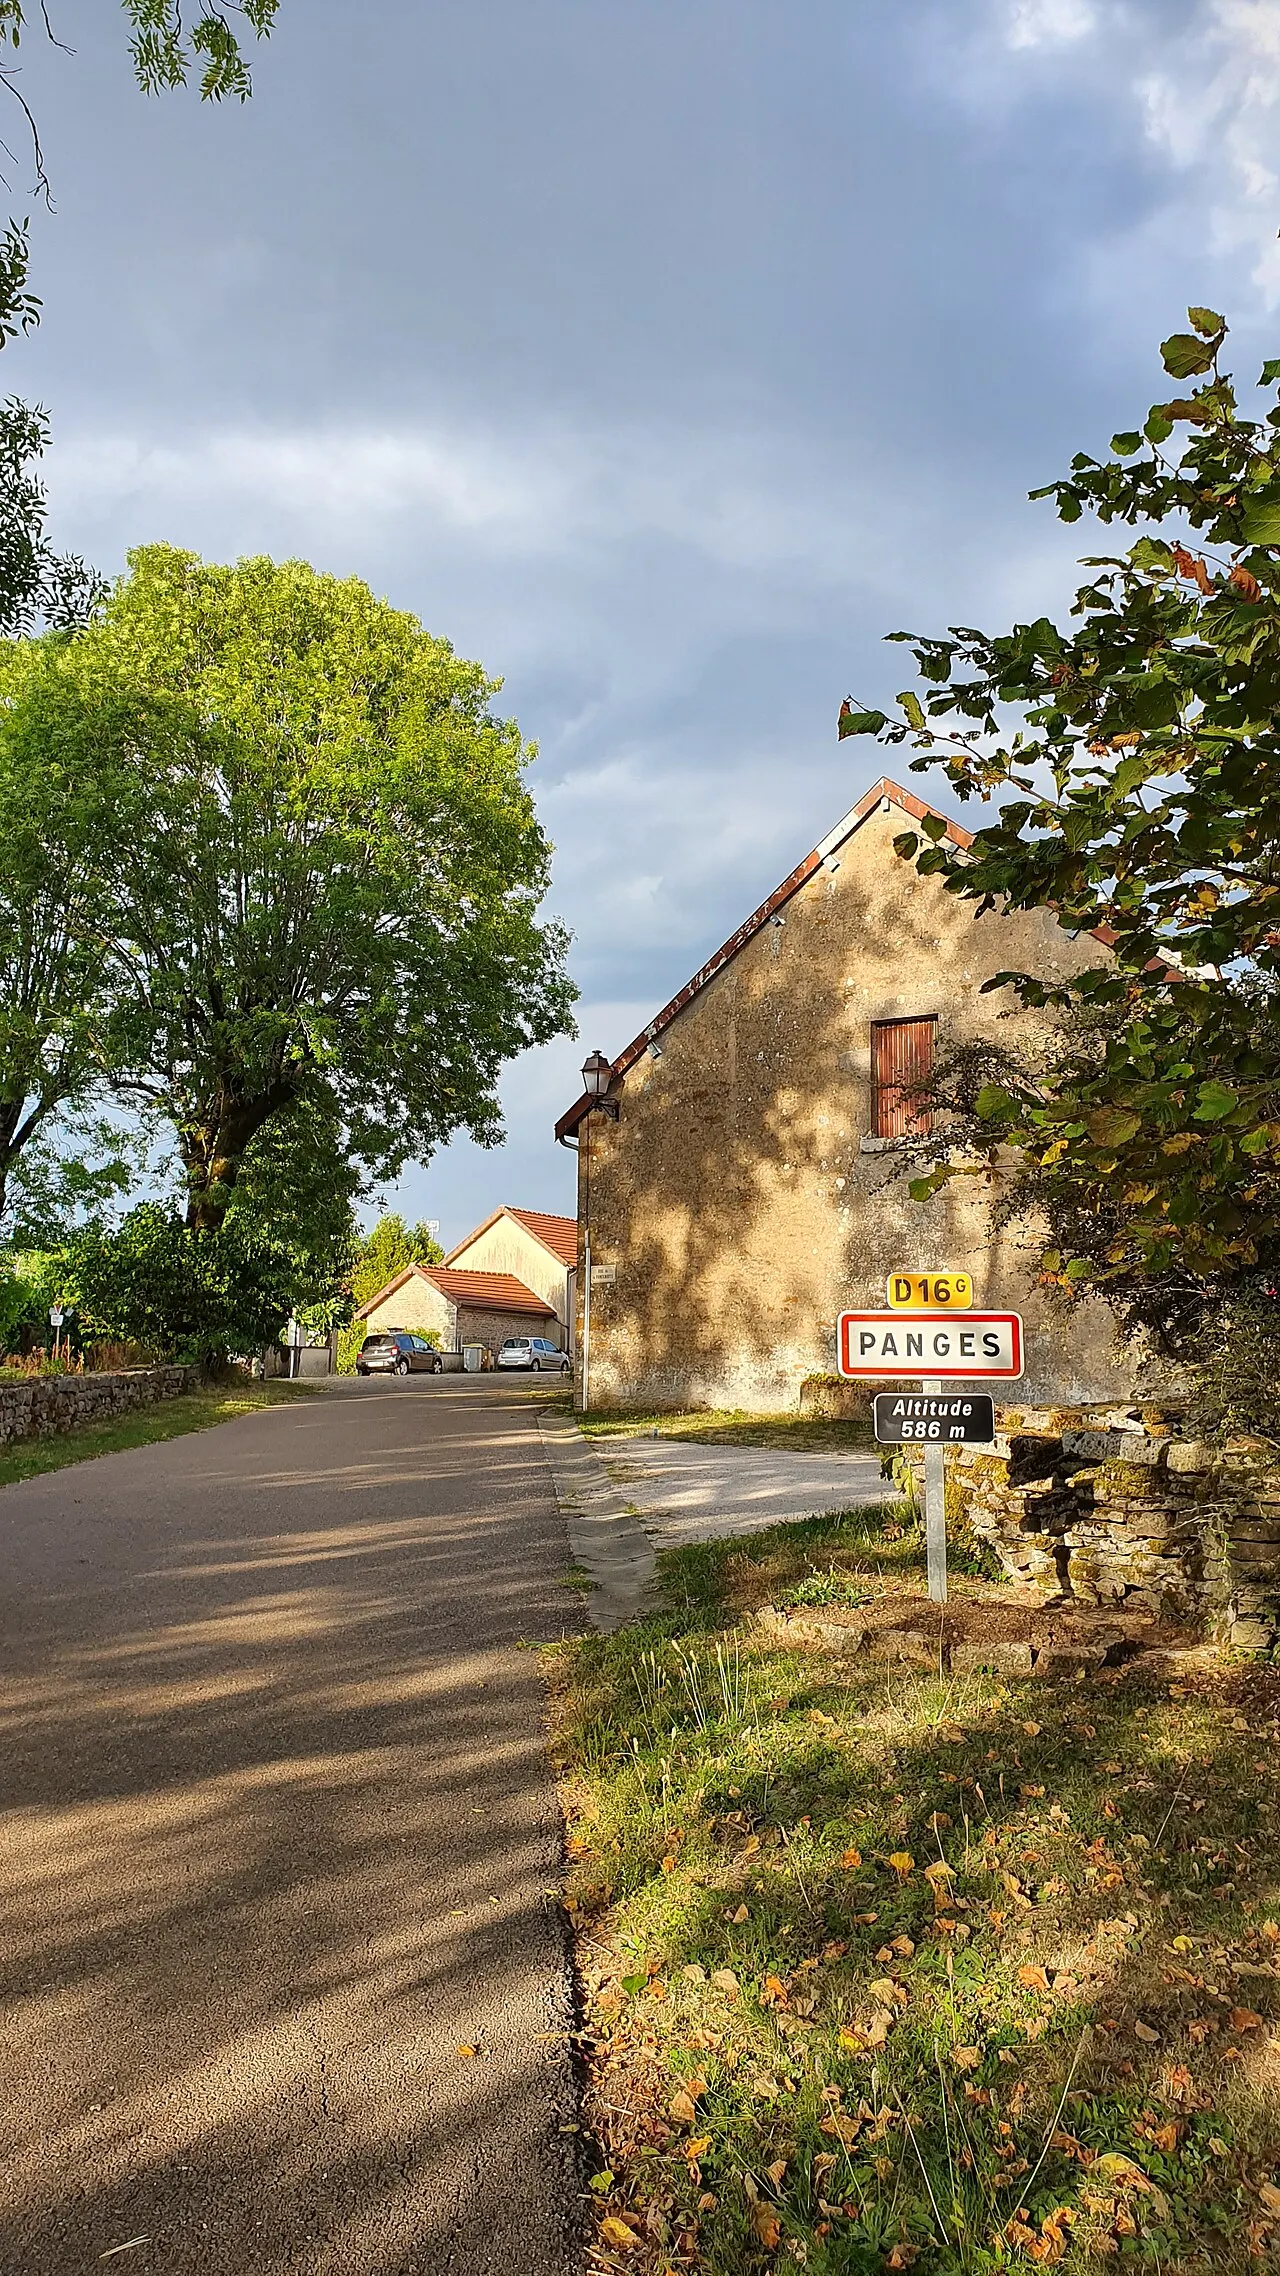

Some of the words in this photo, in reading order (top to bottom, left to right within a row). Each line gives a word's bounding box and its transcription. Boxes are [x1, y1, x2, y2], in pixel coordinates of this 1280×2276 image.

[859, 1332, 1001, 1357] PANGES
[892, 1399, 973, 1416] Altitude
[901, 1421, 941, 1438] 586
[949, 1425, 965, 1439] m
